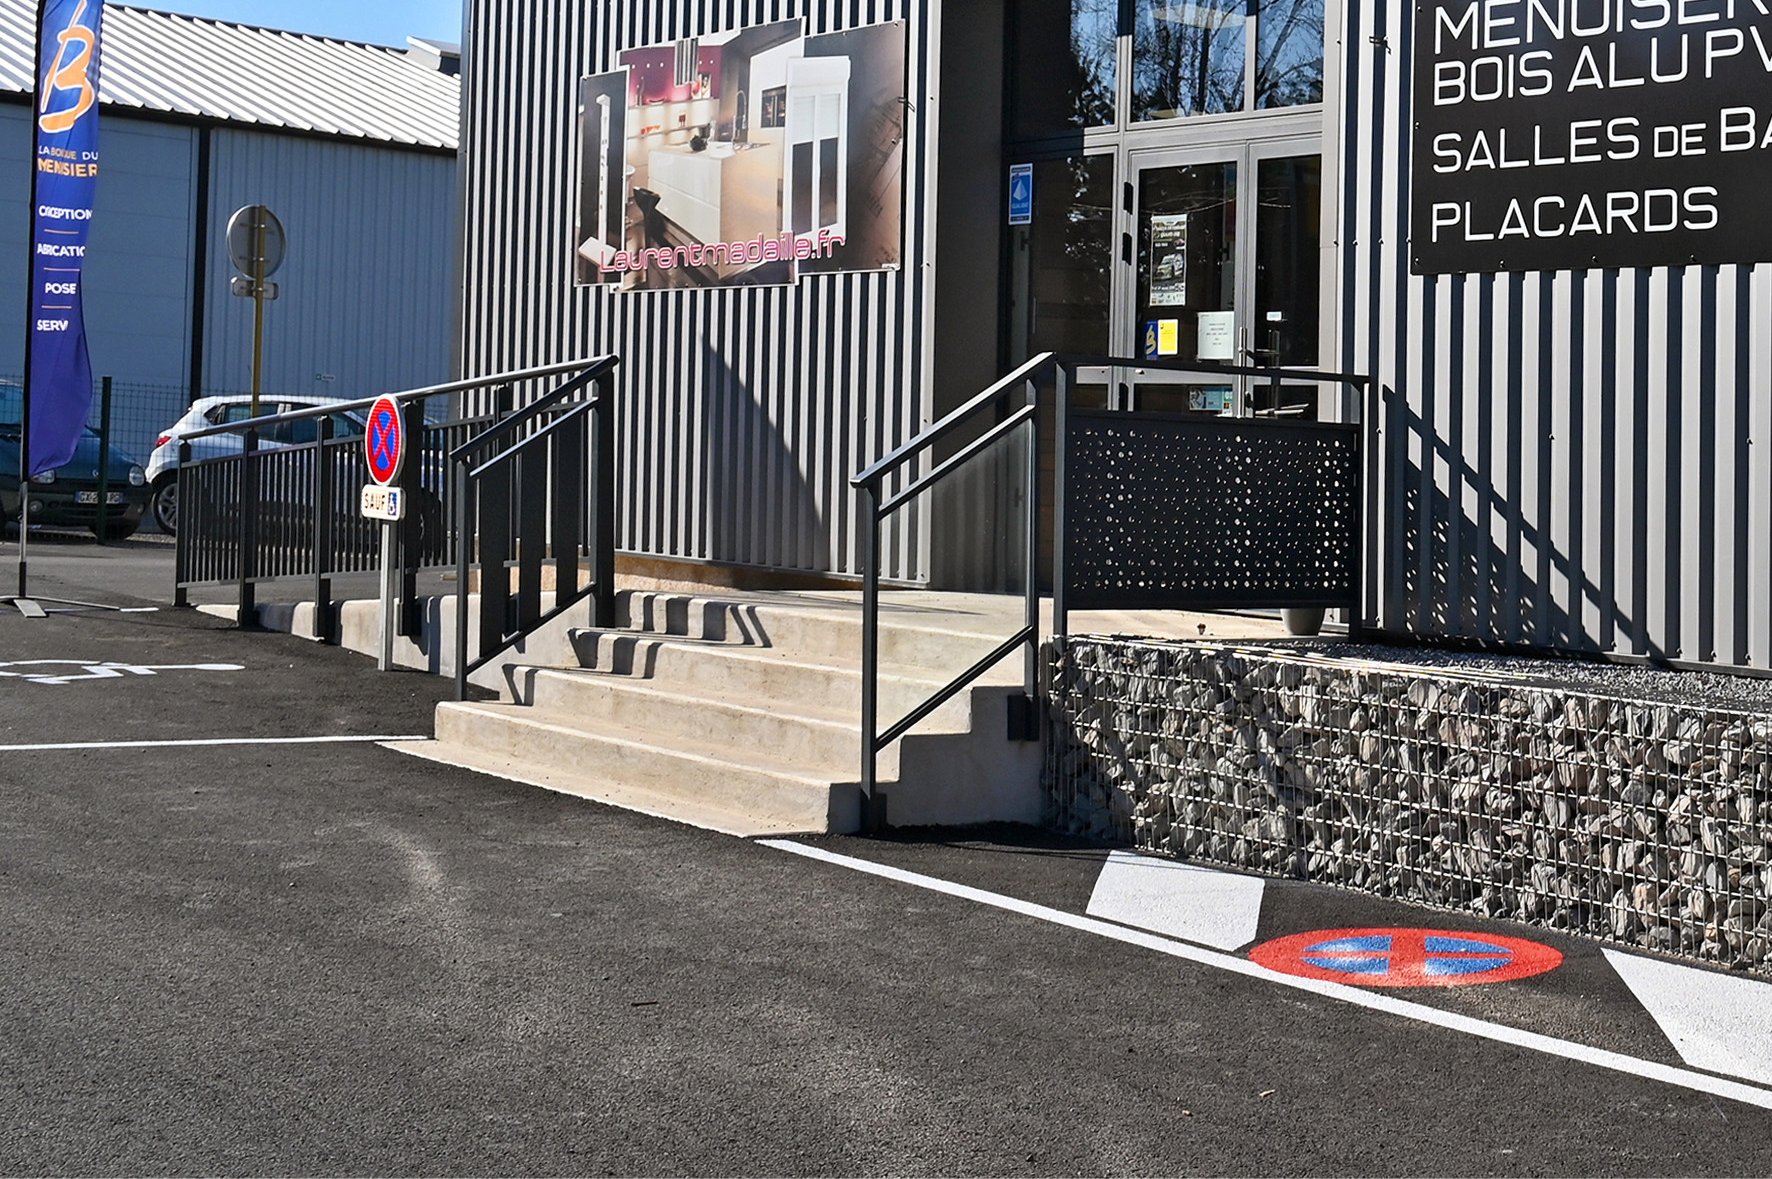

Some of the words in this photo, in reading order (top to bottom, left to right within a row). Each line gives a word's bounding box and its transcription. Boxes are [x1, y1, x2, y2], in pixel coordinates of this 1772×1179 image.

[1433, 50, 1553, 107] BOIS
[1567, 33, 1689, 93] ALU
[38, 145, 50, 154] LA
[82, 151, 99, 160] DU
[1432, 117, 1640, 174] SALLES
[1653, 123, 1707, 158] DE
[1431, 186, 1719, 244] PLACARDS
[599, 229, 846, 273] Laurentmadaille.fr
[45, 282, 77, 294] POSE
[364, 493, 386, 510] SAUF
